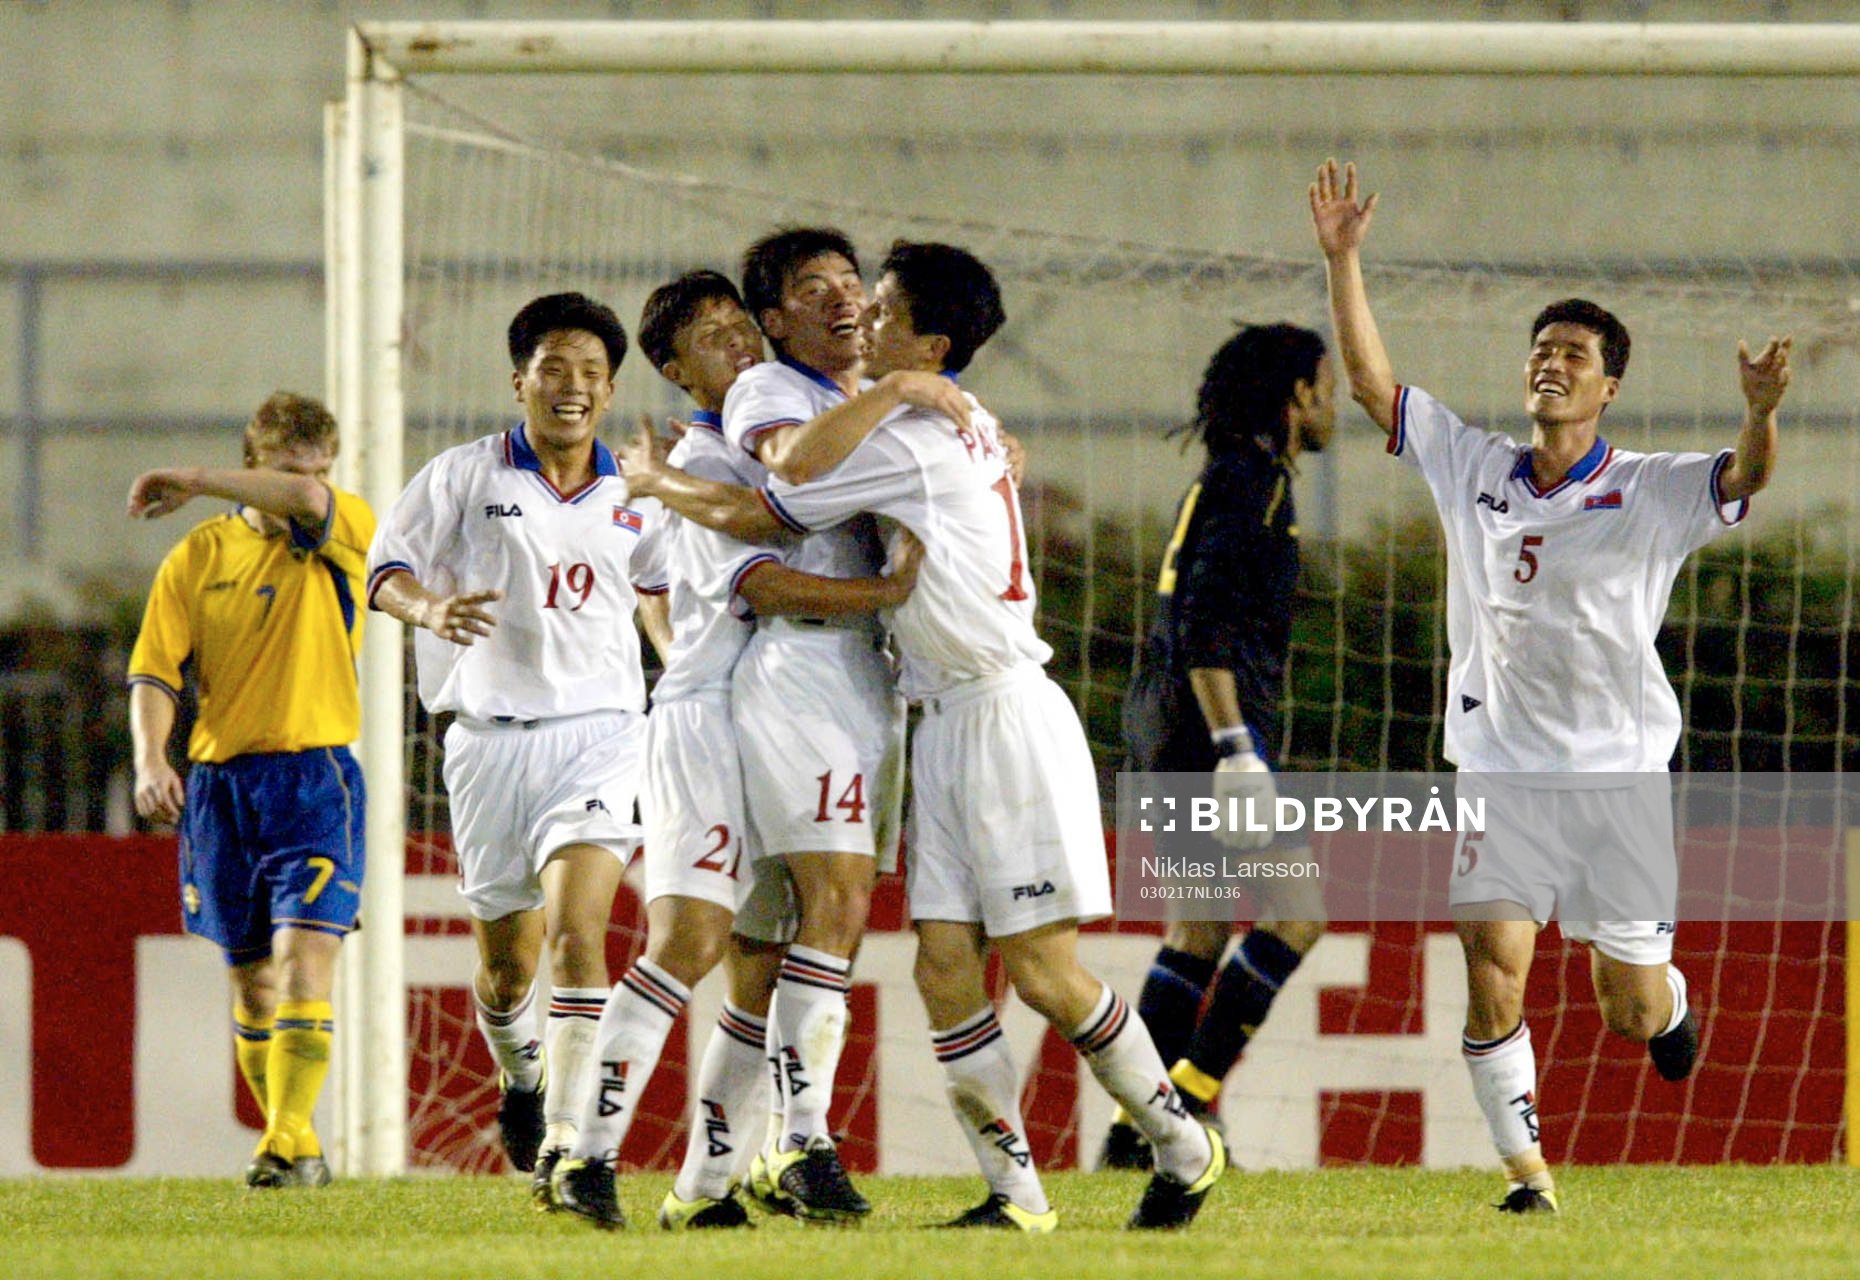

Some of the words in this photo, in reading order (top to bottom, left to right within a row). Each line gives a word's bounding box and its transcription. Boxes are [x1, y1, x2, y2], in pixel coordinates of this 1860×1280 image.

[957, 423, 998, 463] PA
[485, 503, 522, 519] FILA
[1514, 535, 1543, 583] 5
[255, 584, 276, 632] 7
[543, 561, 595, 612] 19
[813, 769, 866, 824] 14
[692, 824, 742, 881] 21
[1457, 831, 1484, 877] 5
[303, 856, 335, 905] 7
[1012, 880, 1055, 901] FILA
[598, 1060, 628, 1117] FILA
[781, 1046, 810, 1096] FILA
[701, 1098, 733, 1157] FILA
[980, 1117, 1030, 1168] FILA
